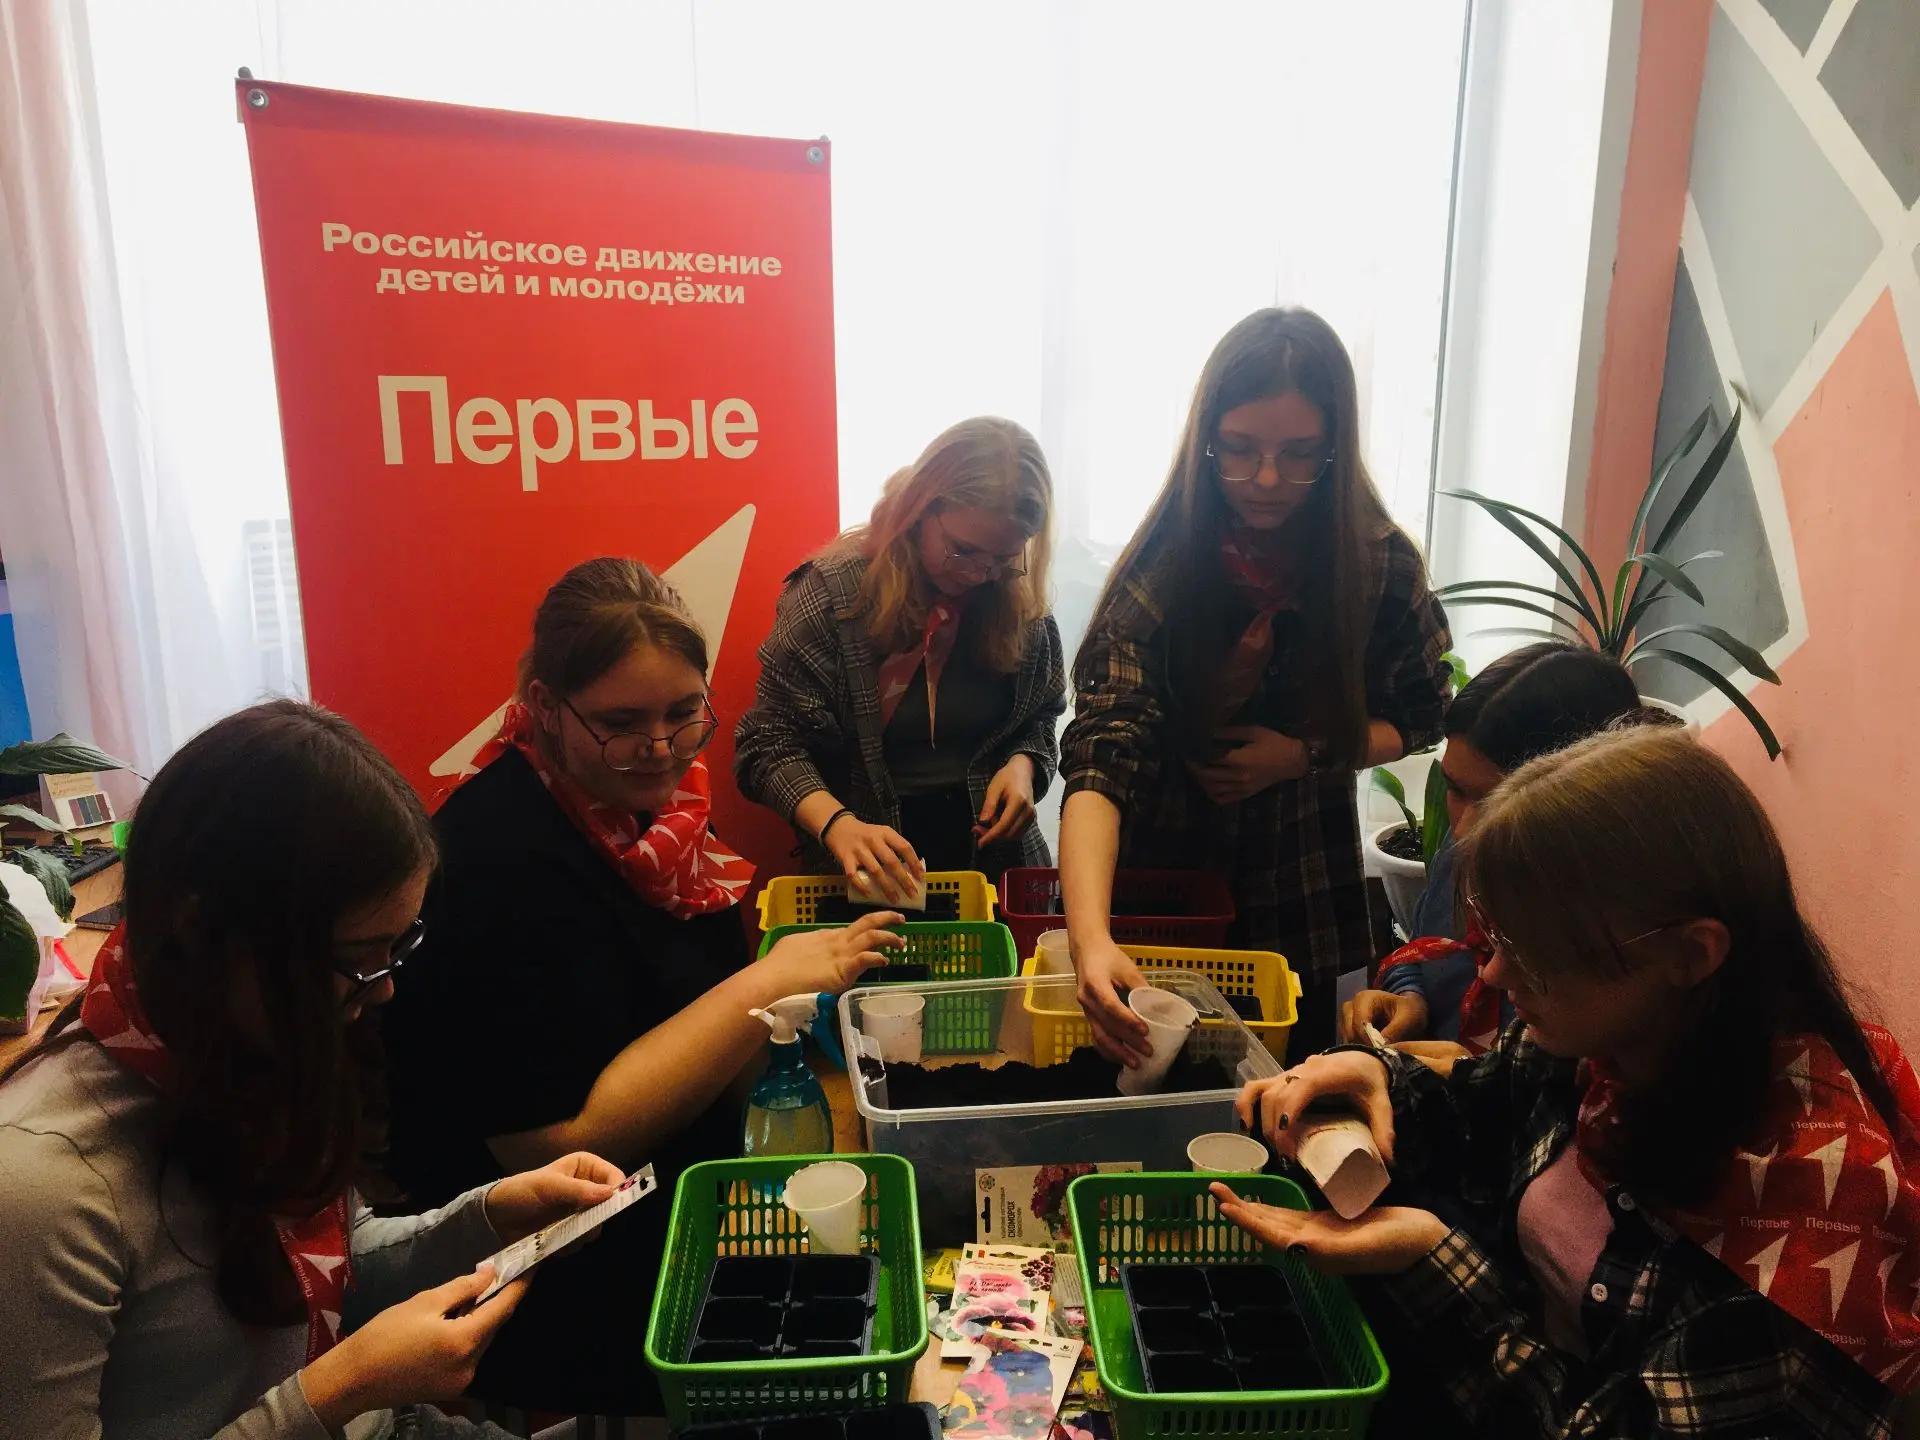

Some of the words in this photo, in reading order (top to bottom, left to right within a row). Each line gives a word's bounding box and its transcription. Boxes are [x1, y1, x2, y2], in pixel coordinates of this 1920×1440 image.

[321, 222, 587, 267] Российское
[595, 247, 782, 277] движение
[376, 266, 505, 295] детей
[516, 276, 541, 295] и
[549, 275, 746, 306] молодёжи
[377, 374, 759, 492] Первые
[1805, 1216, 1862, 1234] Первые
